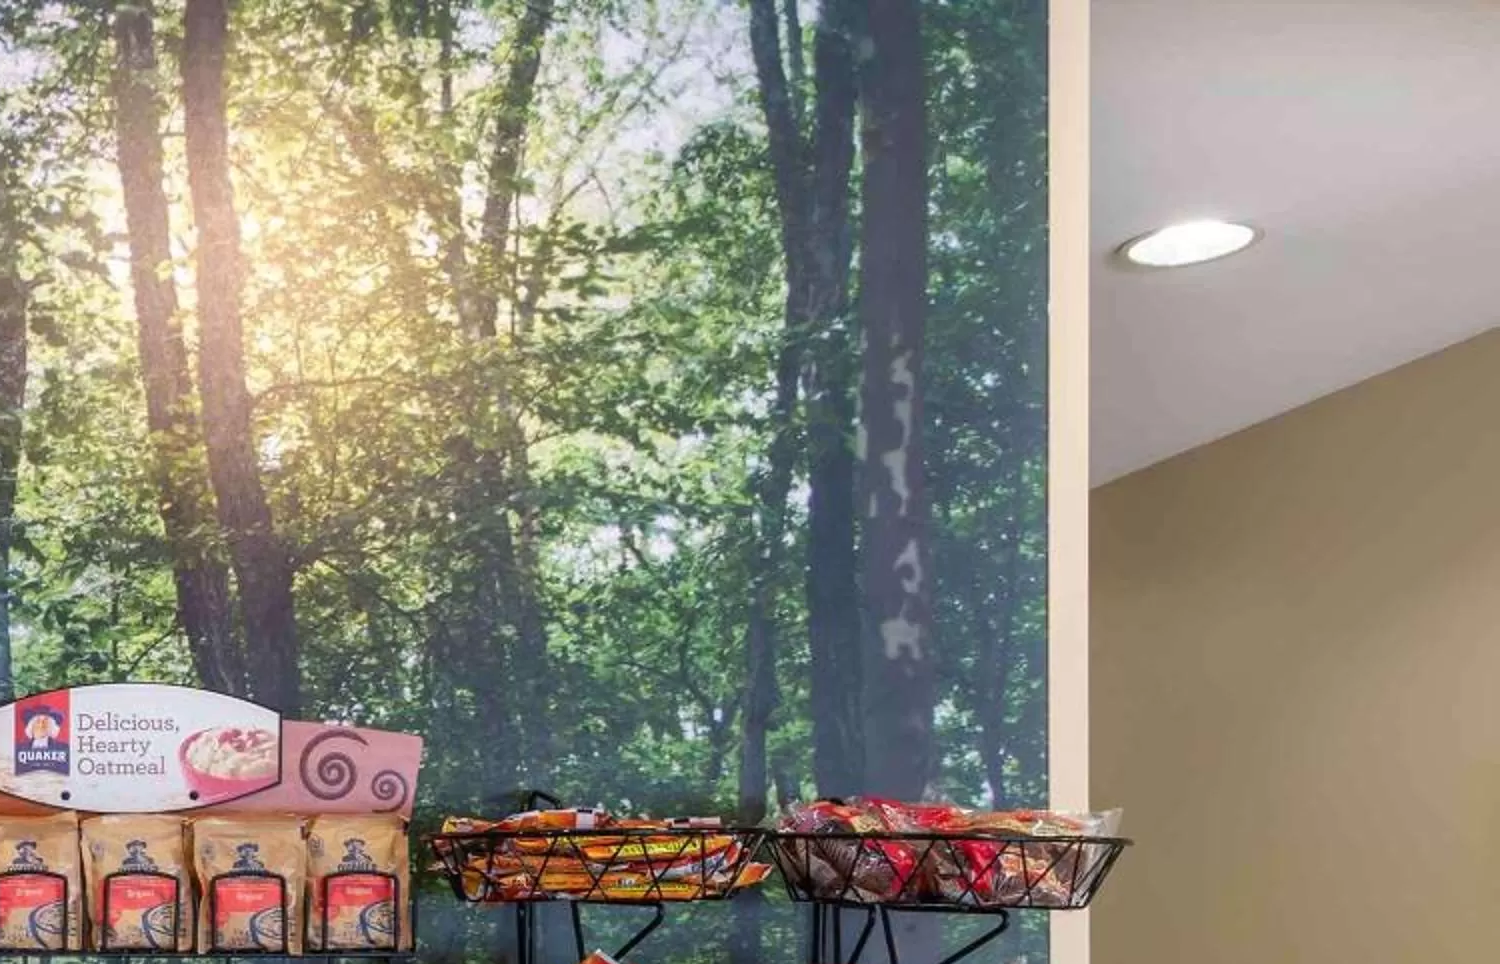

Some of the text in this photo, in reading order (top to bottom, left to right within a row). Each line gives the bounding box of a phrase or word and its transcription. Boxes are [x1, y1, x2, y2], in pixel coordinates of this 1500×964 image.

[77, 711, 181, 733] Delicious,
[18, 750, 67, 763] QUAKER
[77, 735, 152, 757] Hearty
[77, 755, 166, 776] Oatmeal
